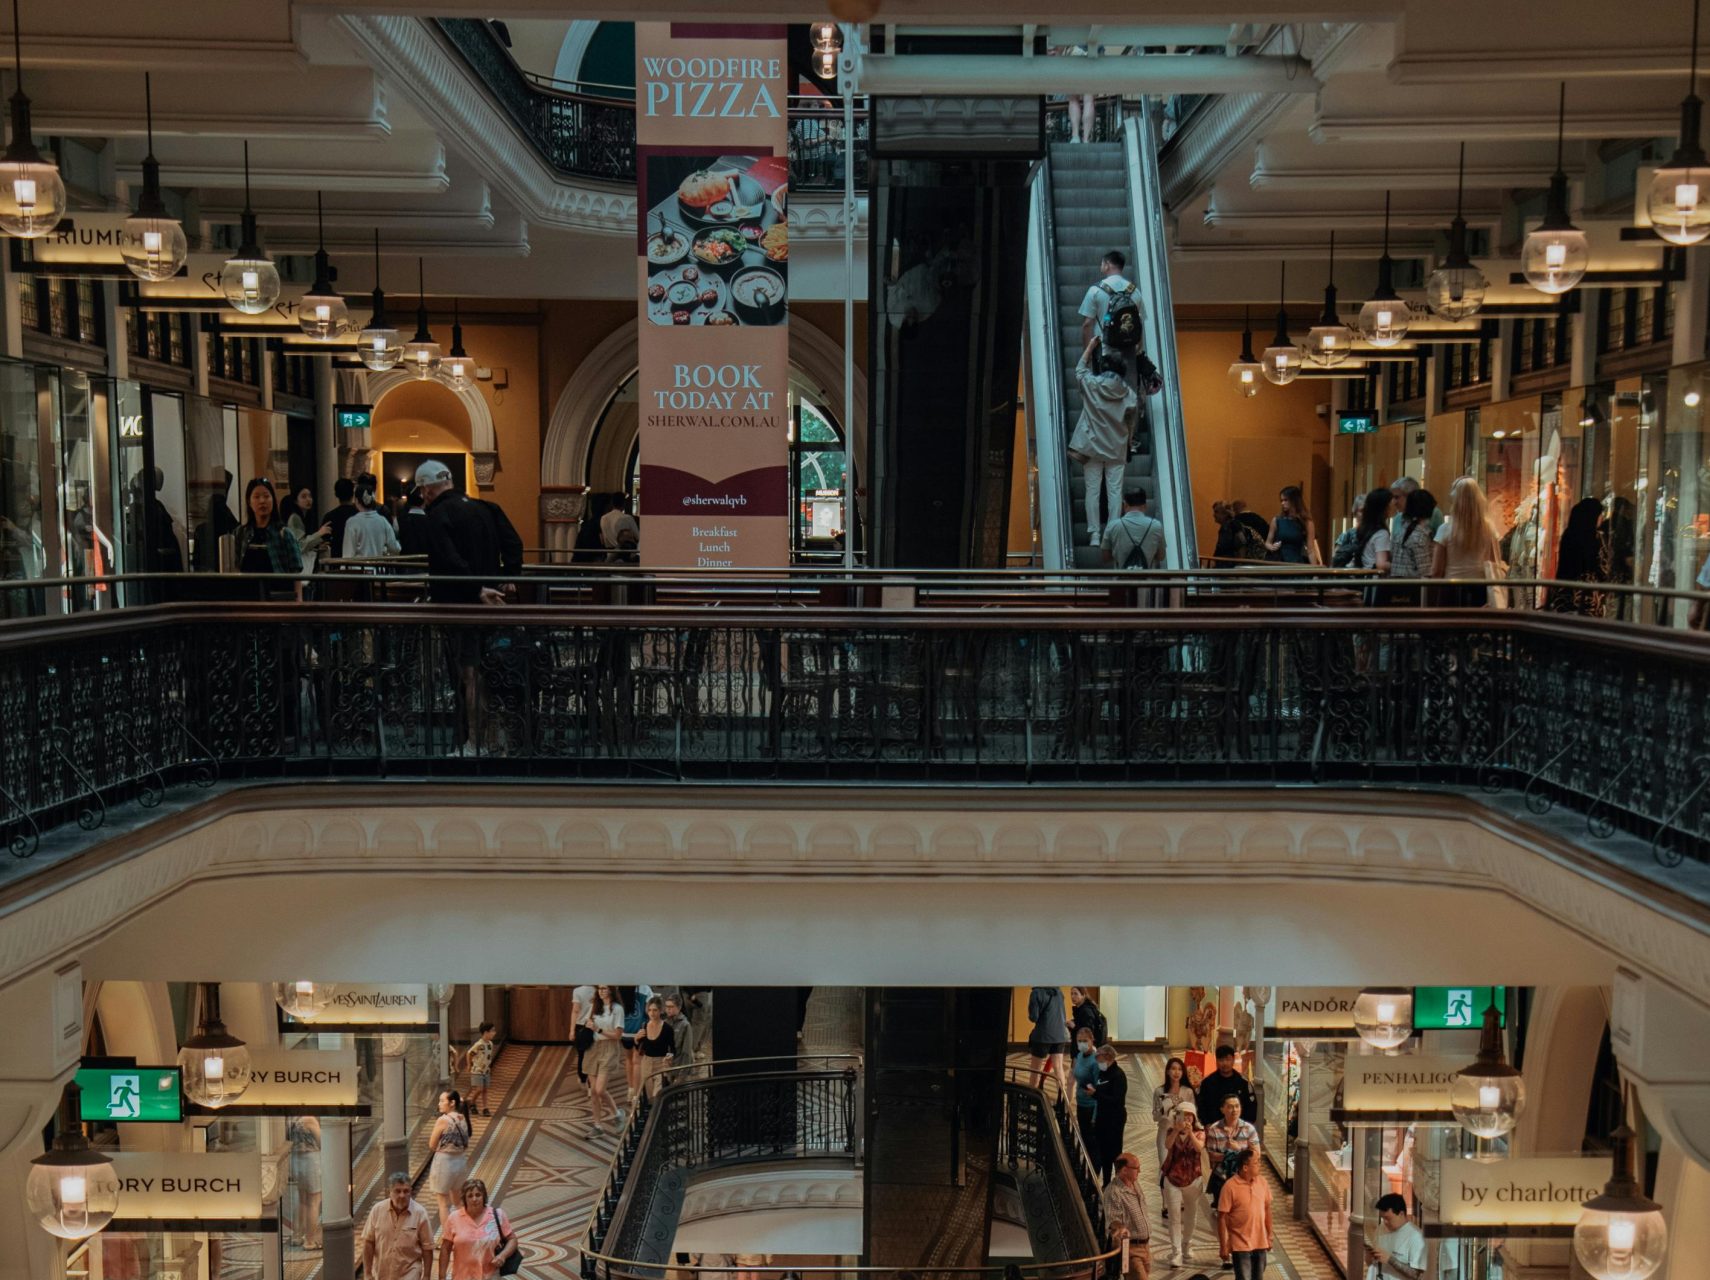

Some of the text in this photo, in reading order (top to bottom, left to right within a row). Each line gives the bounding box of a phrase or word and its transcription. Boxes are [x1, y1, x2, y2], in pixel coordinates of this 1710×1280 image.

[643, 57, 781, 79] WOODFIRE
[645, 81, 782, 118] PIZZA
[673, 364, 762, 388] BOOK
[654, 391, 774, 410] TODAY AT
[647, 415, 780, 428] SHERWAL.COM.AU
[682, 494, 747, 509] @sherwalqvb
[692, 526, 737, 537] Breakfast
[699, 542, 731, 553] Lunch
[697, 557, 732, 567] Dinner
[275, 1071, 340, 1083] BURCH
[162, 1178, 241, 1192] BURCH
[1461, 1181, 1599, 1207] by charlotte
